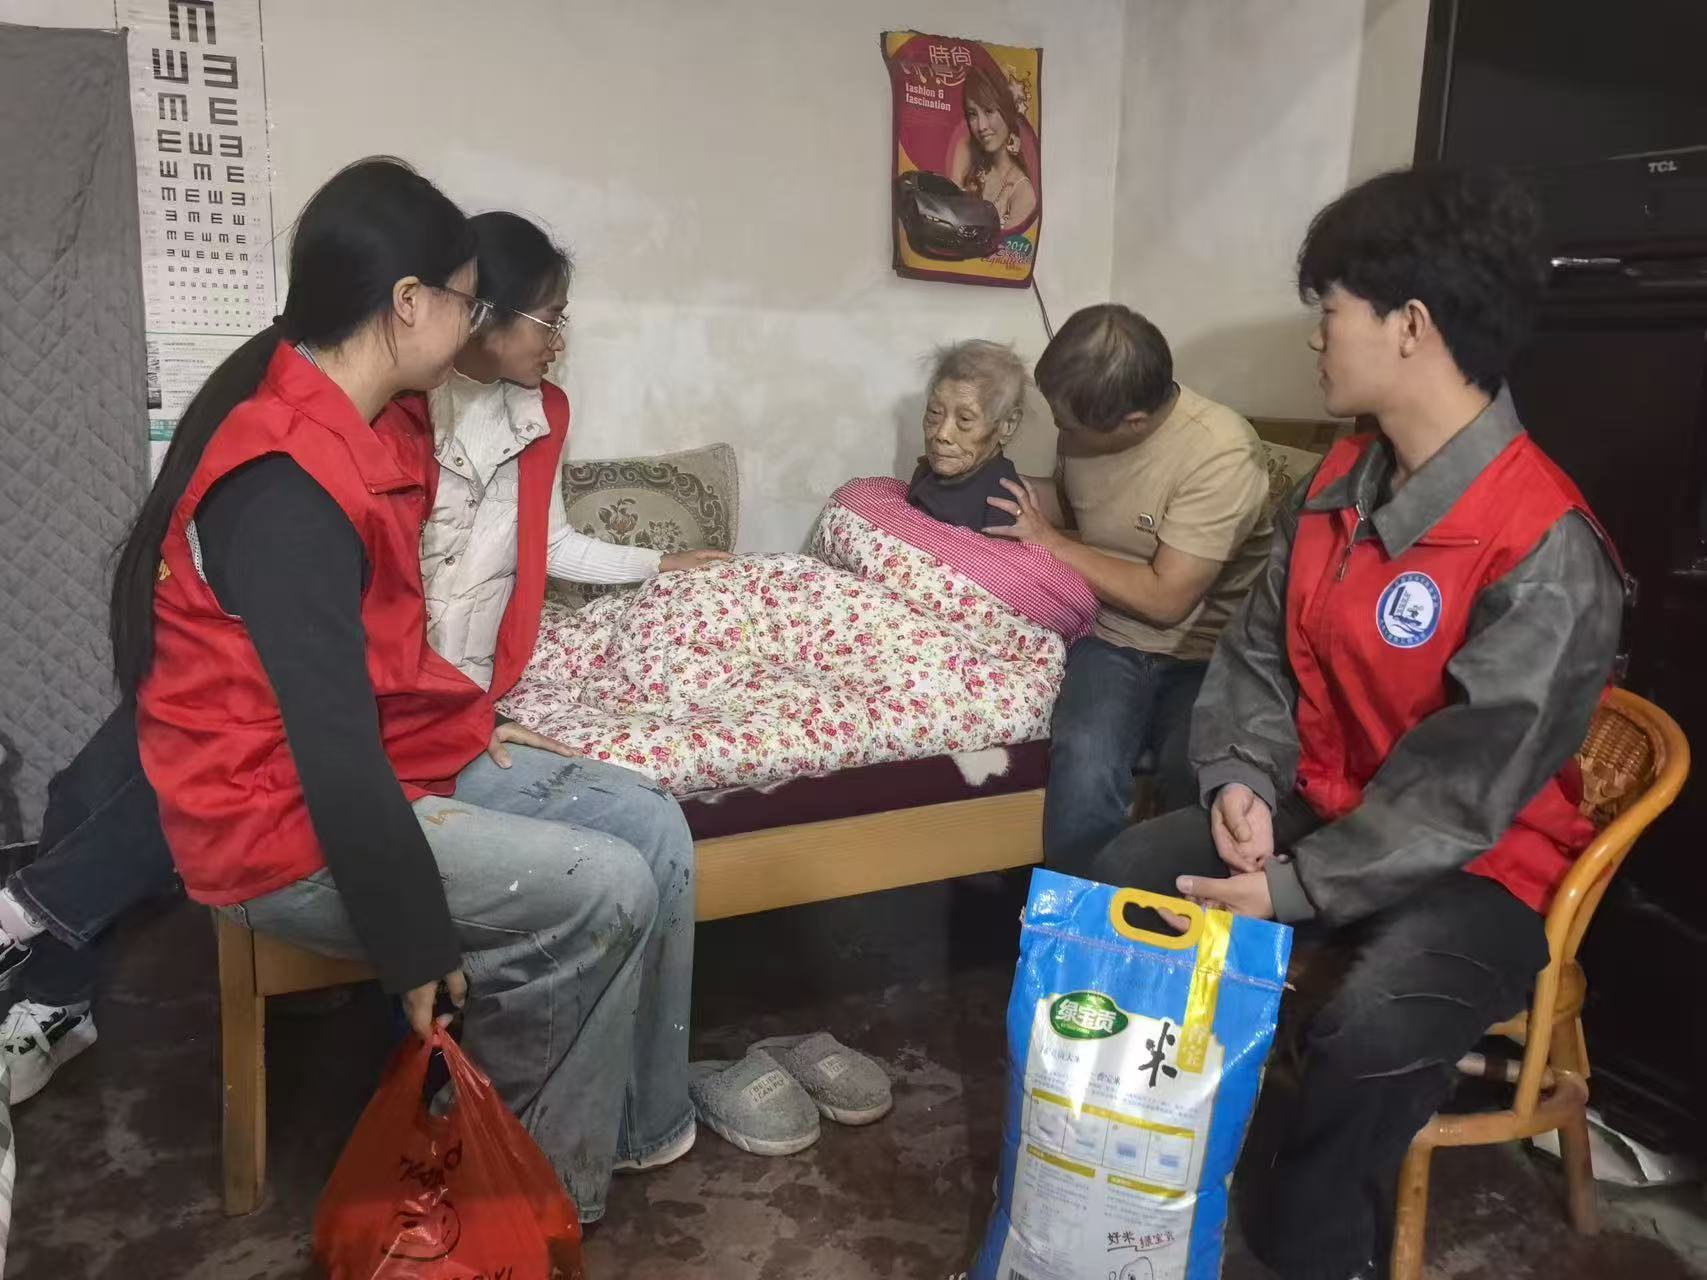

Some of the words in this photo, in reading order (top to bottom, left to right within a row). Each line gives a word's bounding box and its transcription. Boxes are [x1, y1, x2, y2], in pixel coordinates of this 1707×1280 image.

[929, 45, 972, 67] 時尚
[905, 82, 936, 98] fashion
[906, 92, 951, 111] fascination
[1648, 160, 1678, 173] TCL
[1006, 240, 1030, 252] 2011
[1138, 1021, 1178, 1089] 米
